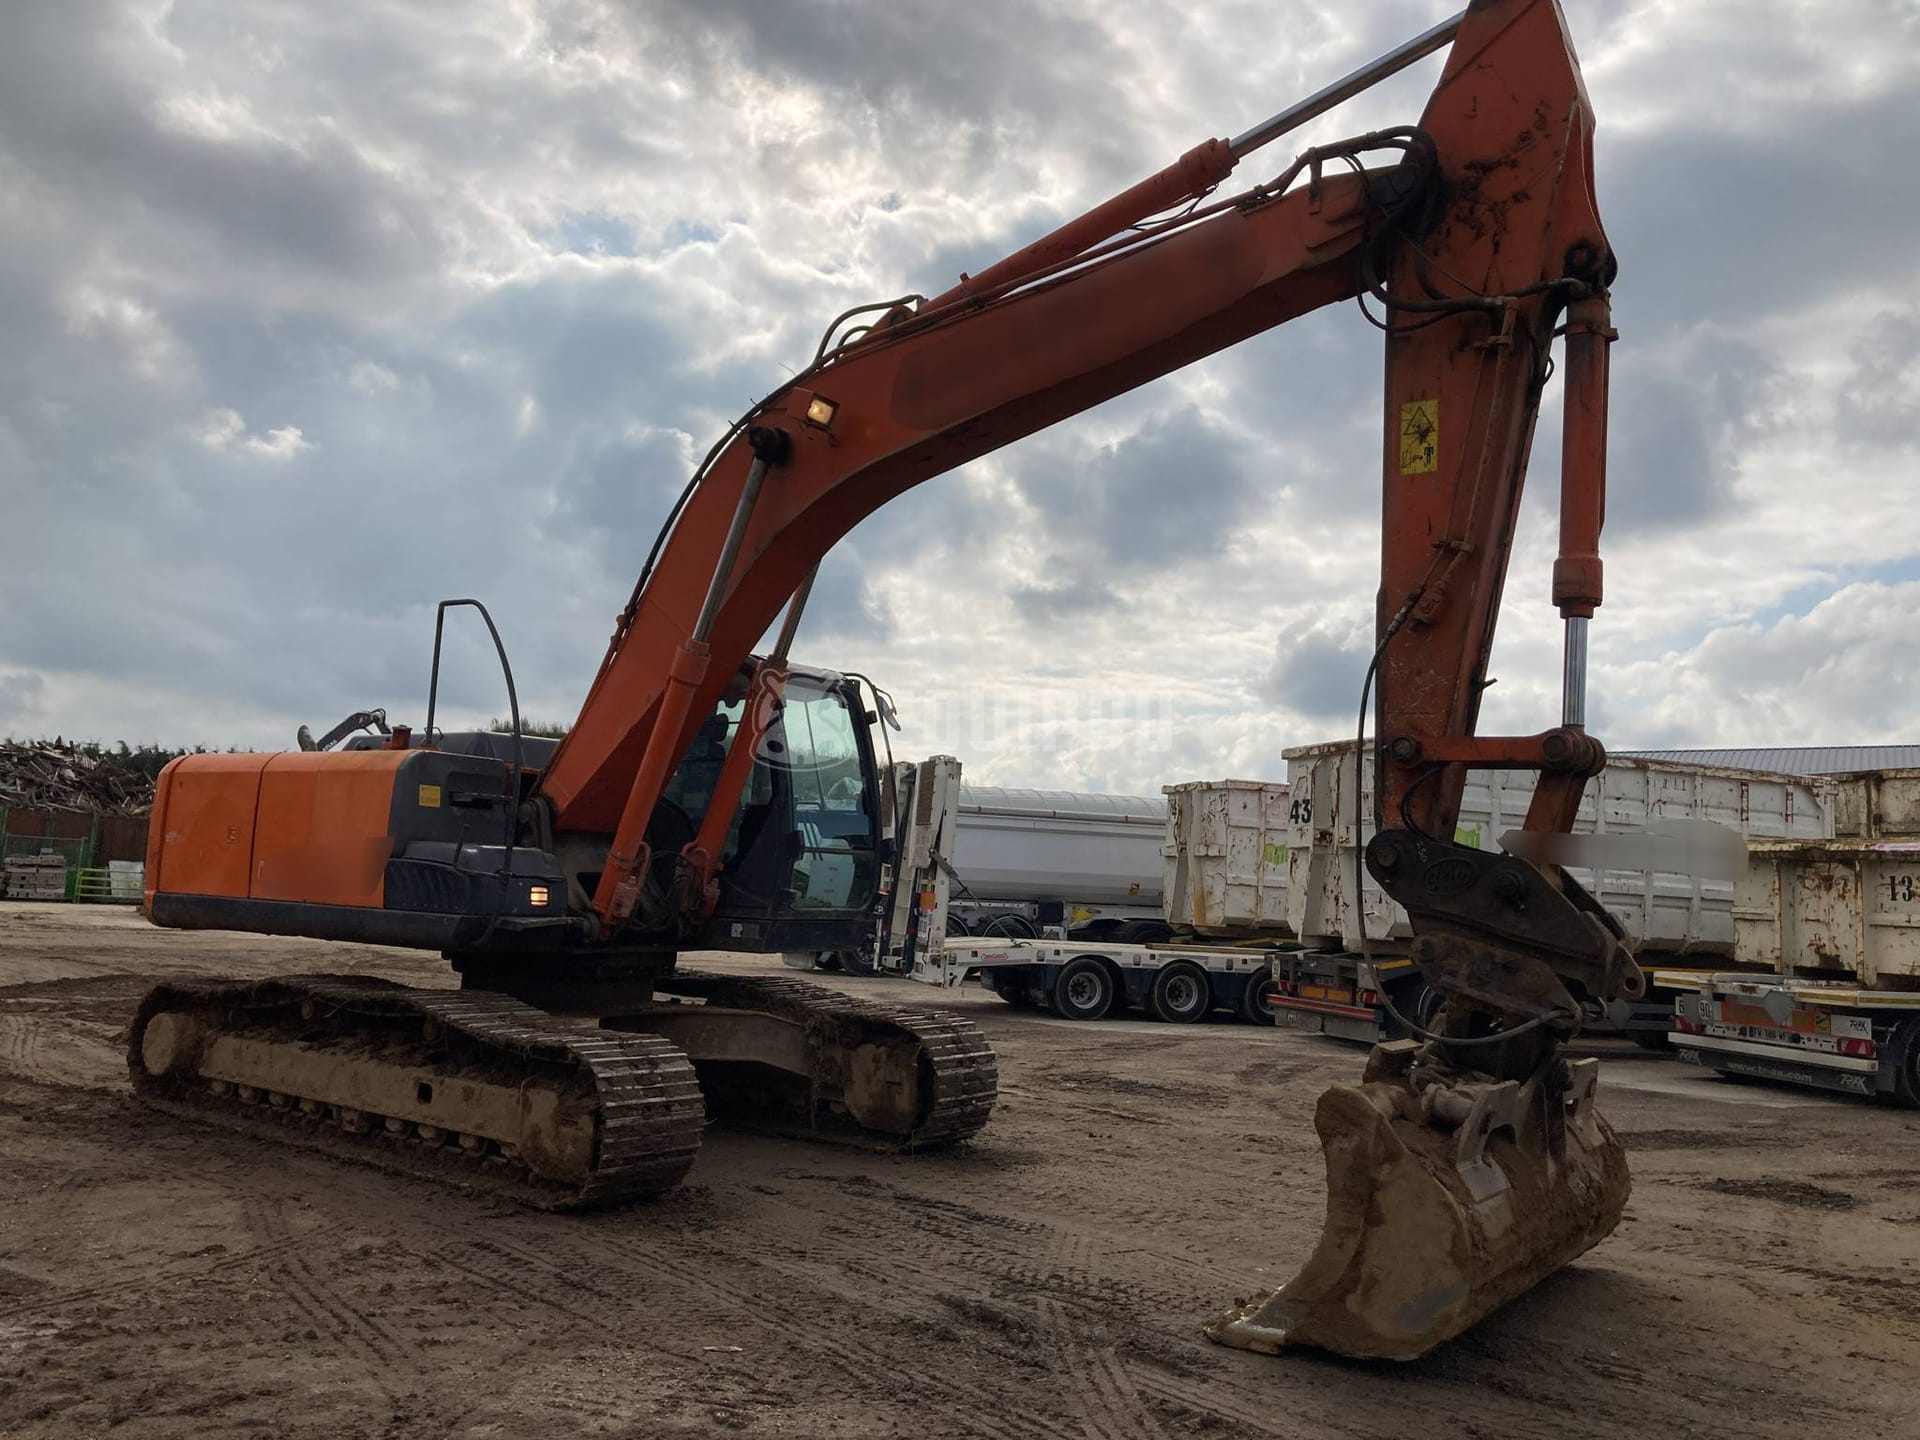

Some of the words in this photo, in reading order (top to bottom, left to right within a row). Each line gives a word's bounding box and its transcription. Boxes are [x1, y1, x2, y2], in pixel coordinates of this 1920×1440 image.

[1289, 799, 1311, 824] 43
[1889, 875, 1913, 902] 13
[1699, 1002, 1711, 1018] 90
